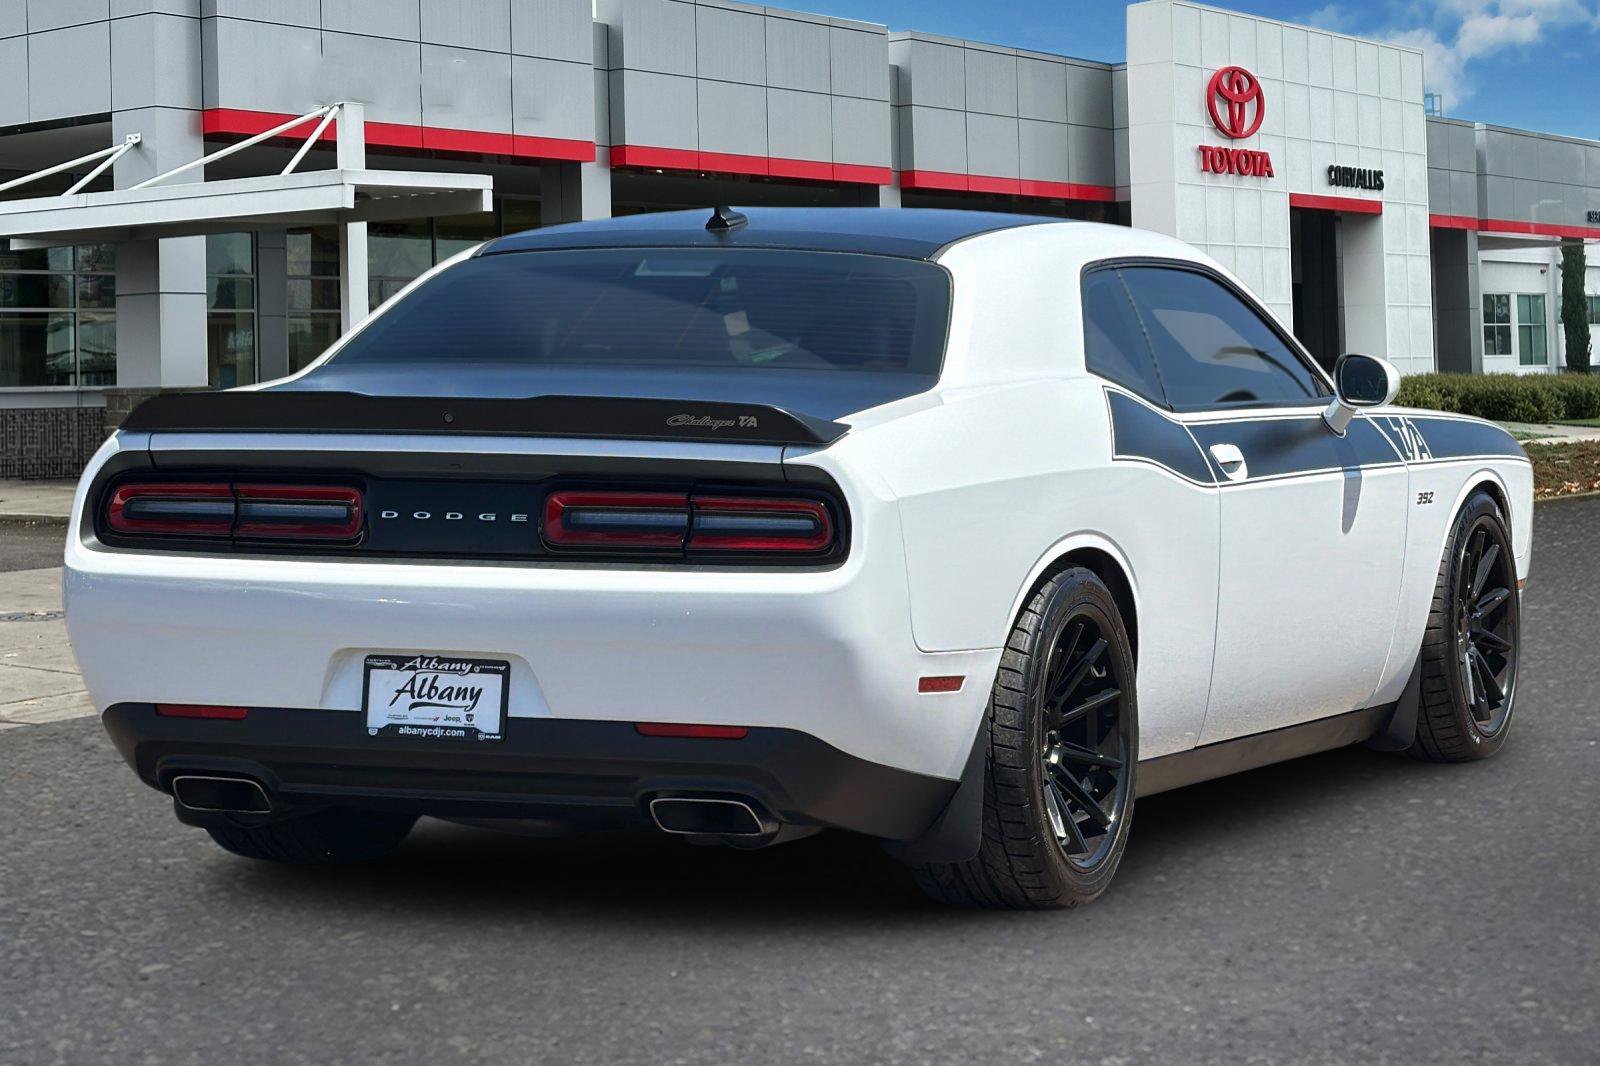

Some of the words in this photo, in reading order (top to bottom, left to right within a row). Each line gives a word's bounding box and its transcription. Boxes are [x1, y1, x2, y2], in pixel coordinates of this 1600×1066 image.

[1199, 145, 1274, 177] TOYOTA
[1327, 164, 1384, 190] CORVALLIS
[1416, 492, 1434, 505] 392
[381, 510, 528, 522] DODGE
[399, 656, 473, 676] Albany
[389, 675, 483, 711] Albany
[443, 714, 460, 723] Jeep
[398, 726, 466, 738] albanycdjr.com
